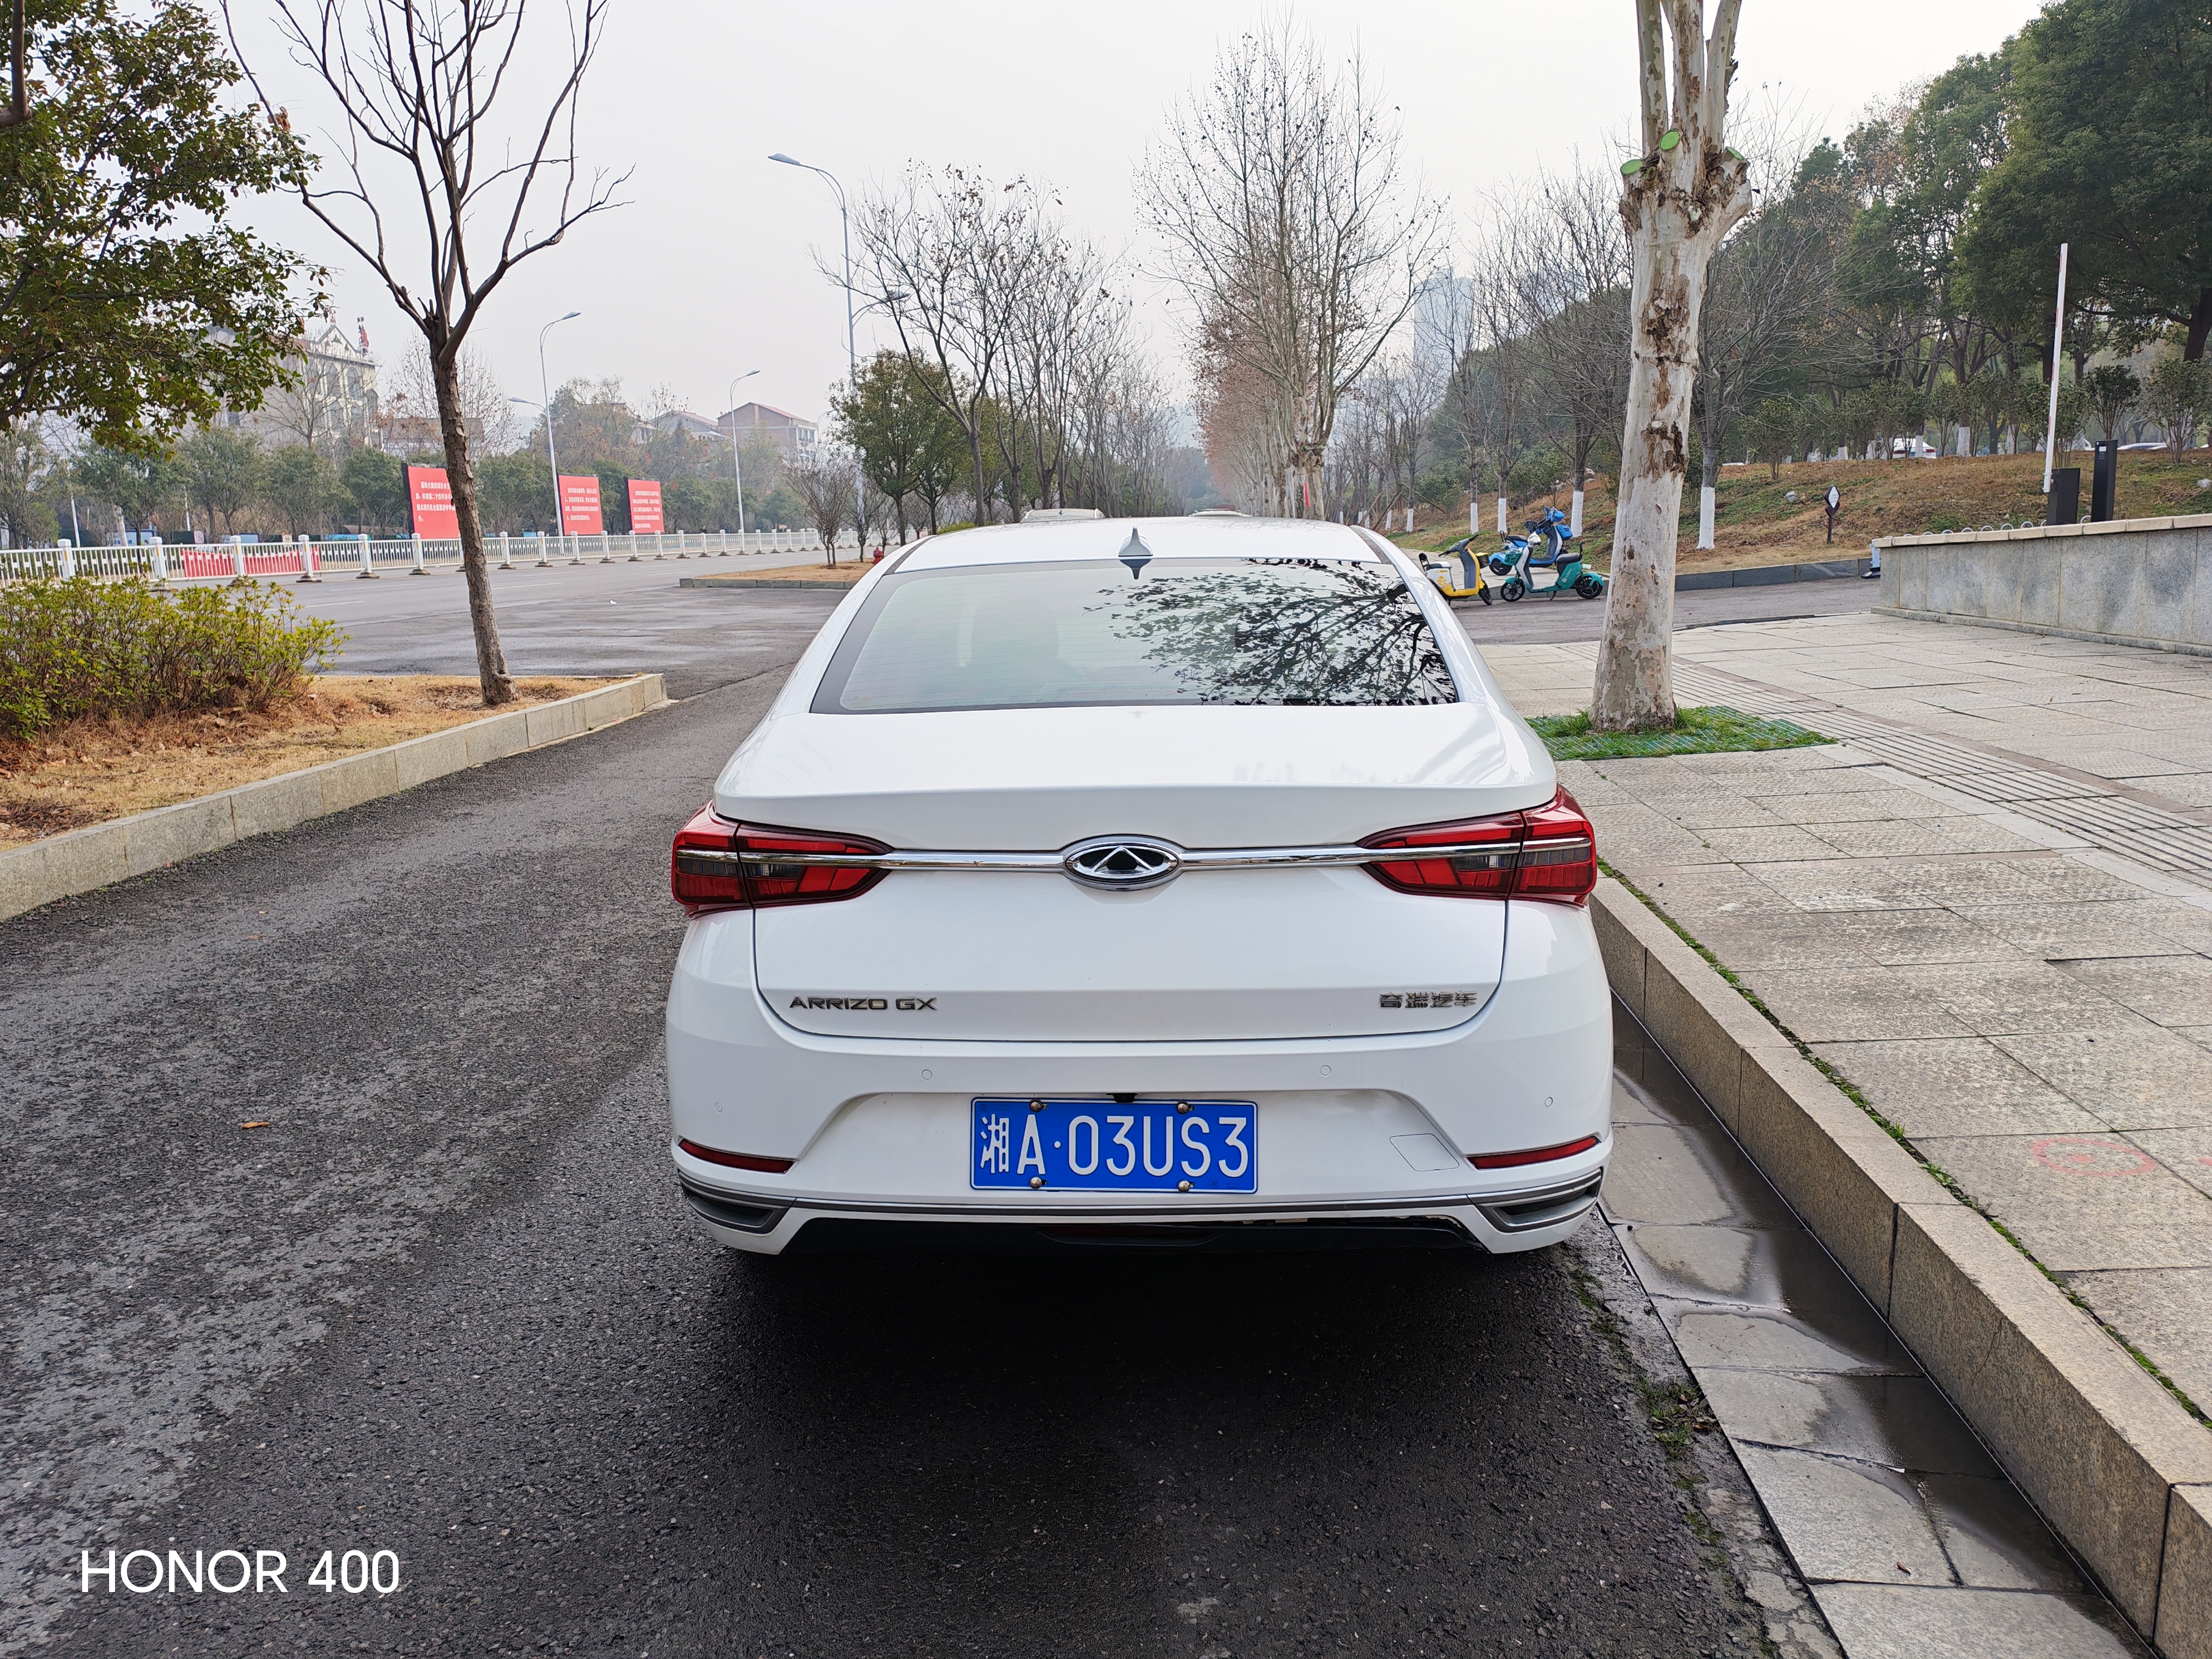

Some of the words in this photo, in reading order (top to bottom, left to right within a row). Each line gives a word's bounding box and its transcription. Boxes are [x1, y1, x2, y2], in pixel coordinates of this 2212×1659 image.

[789, 996, 888, 1010] ARRIZO
[895, 997, 938, 1010] GX
[1380, 990, 1478, 1008] 奇瑞汽车
[980, 1114, 1249, 1177] 湘A·03US3
